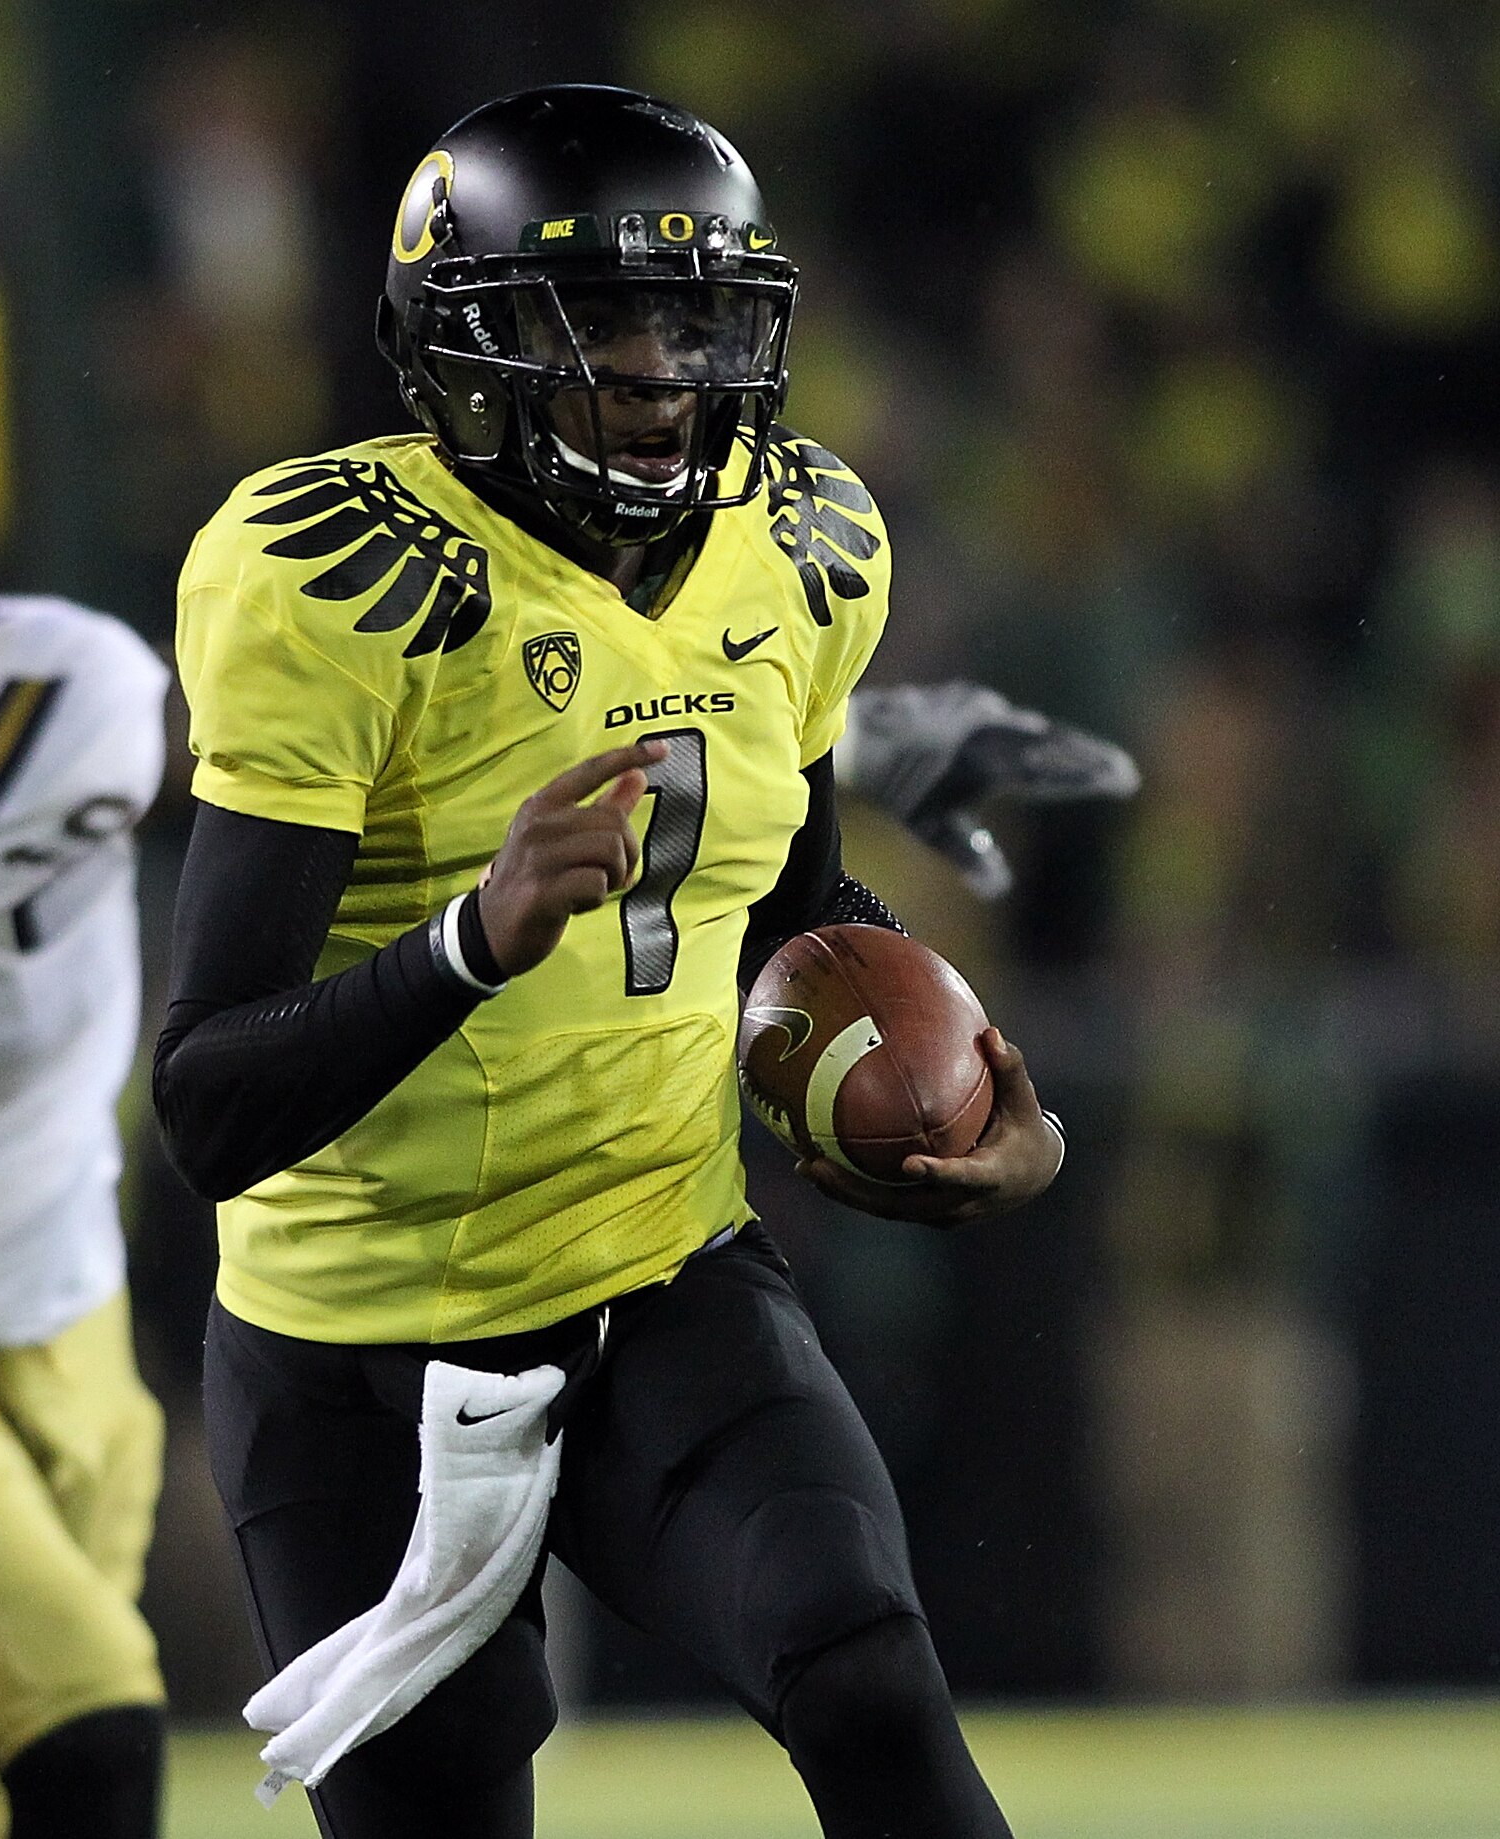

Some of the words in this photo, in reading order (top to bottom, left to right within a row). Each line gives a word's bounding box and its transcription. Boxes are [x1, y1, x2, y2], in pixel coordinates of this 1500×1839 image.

[541, 219, 576, 240] NIKE
[659, 213, 695, 242] O
[462, 302, 499, 356] Ridd
[615, 502, 660, 518] Riddell
[527, 635, 580, 684] PAC
[543, 667, 574, 696] 10
[604, 692, 735, 729] DUCKS
[619, 727, 708, 997] 1
